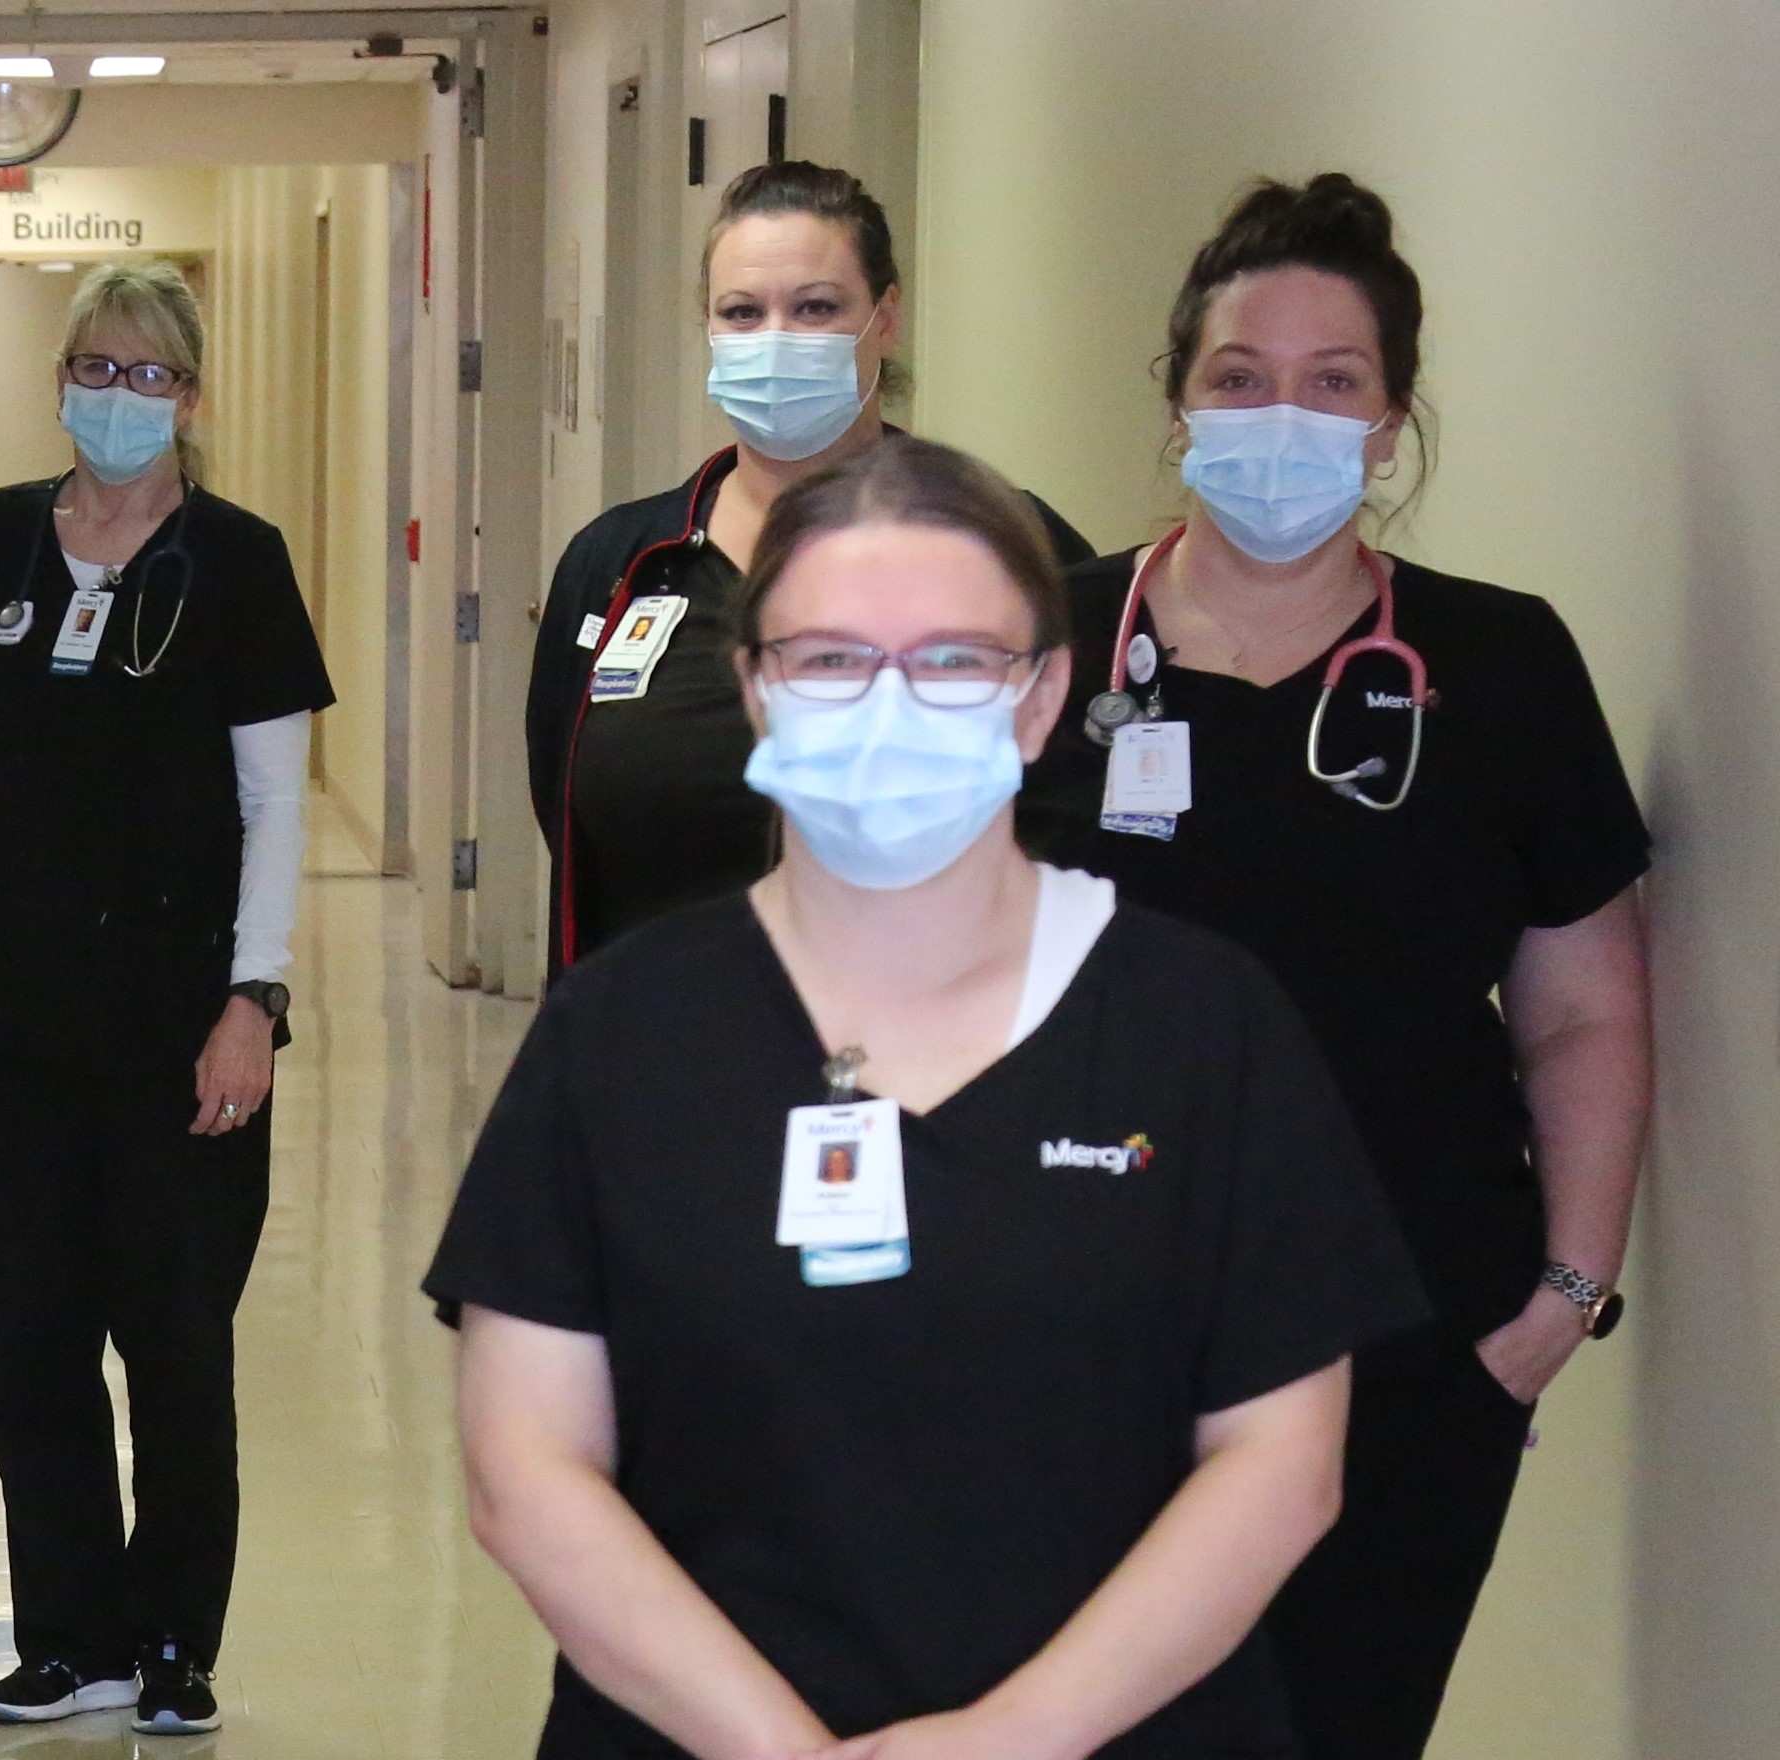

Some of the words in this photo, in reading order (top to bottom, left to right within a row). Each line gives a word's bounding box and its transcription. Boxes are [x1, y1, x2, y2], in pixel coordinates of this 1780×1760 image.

[13, 213, 142, 246] Building
[1365, 691, 1413, 708] Merc
[1040, 1137, 1130, 1175] Mercy
